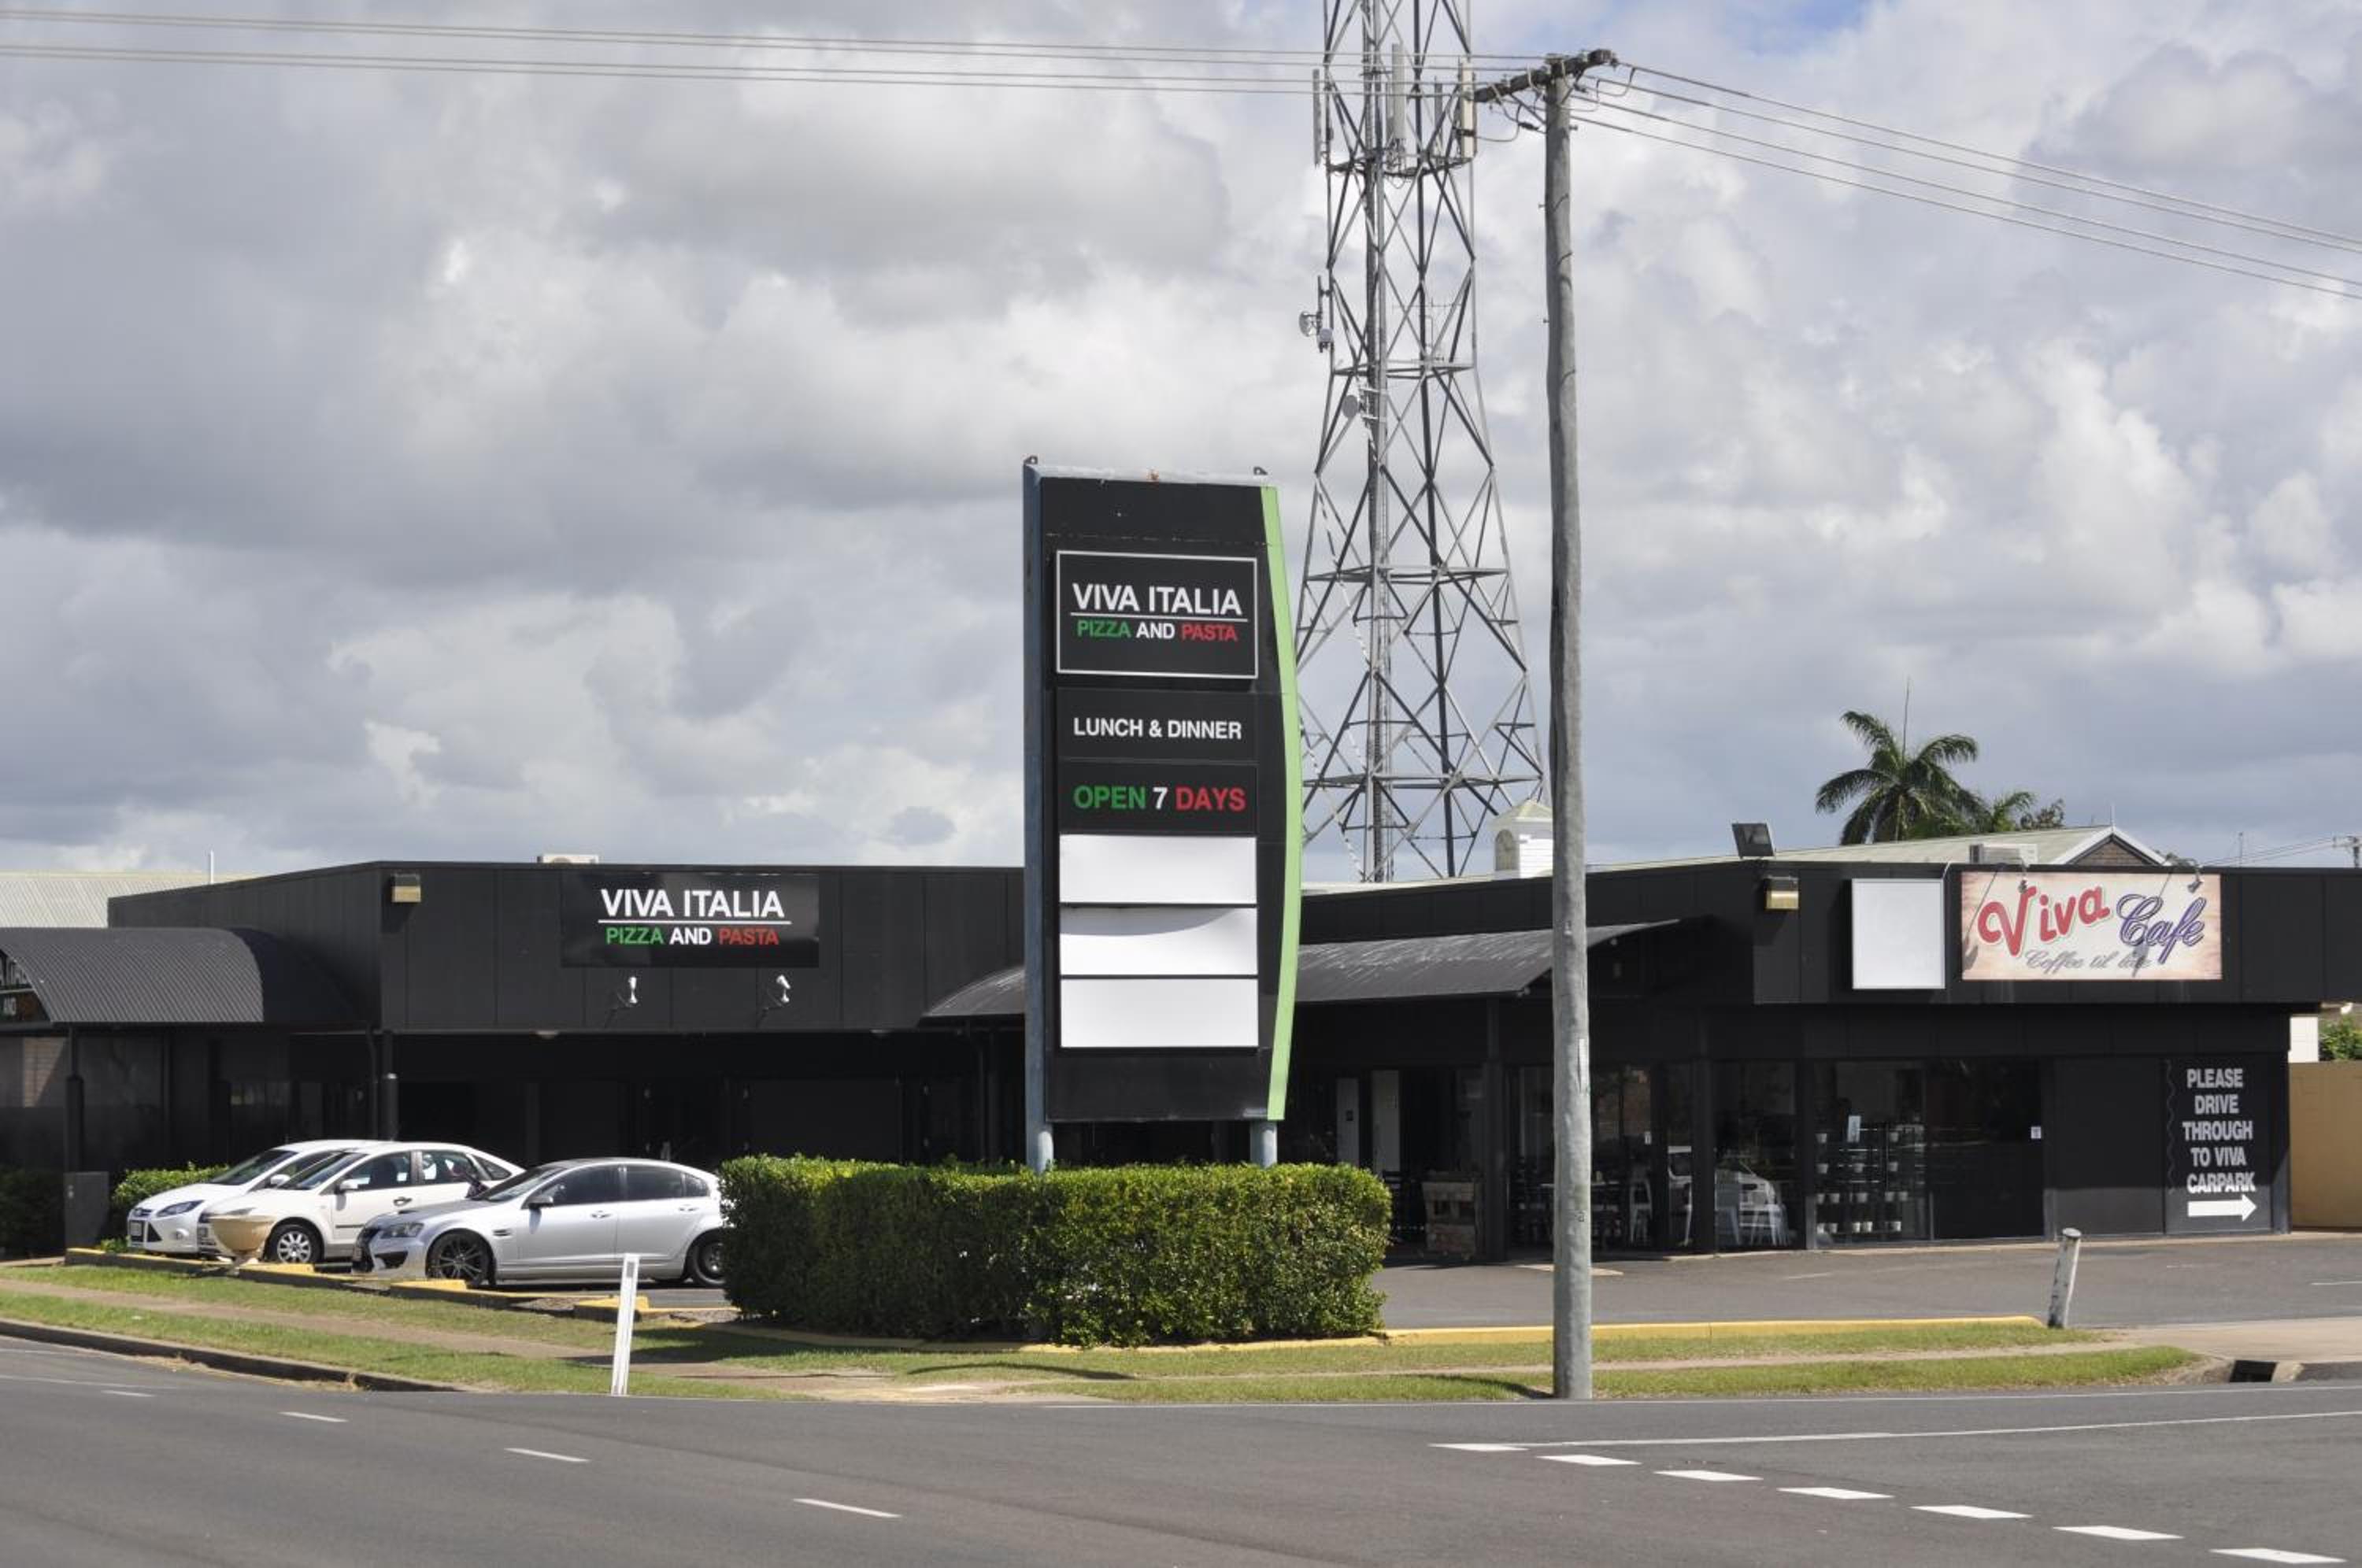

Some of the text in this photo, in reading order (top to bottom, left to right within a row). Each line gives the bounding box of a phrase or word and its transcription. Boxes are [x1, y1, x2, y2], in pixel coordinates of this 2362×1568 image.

[1072, 582, 1243, 616] VIVA ITALIA
[1077, 619, 1238, 642] PIZZA AND PASTA
[1073, 718, 1242, 739] LUNCH & DINNER
[1074, 786, 1246, 811] OPEN 7 DAYS
[601, 889, 785, 918] VIVA ITALIA
[1977, 886, 2111, 956] Viva
[605, 927, 779, 945] PIZZA AND PASTA
[2186, 1068, 2244, 1089] PLEASE
[2194, 1095, 2239, 1115] DRIVE
[2182, 1120, 2253, 1141] THROUGH
[2190, 1147, 2247, 1167] TO VIVA
[2187, 1172, 2256, 1193] CARPARK
